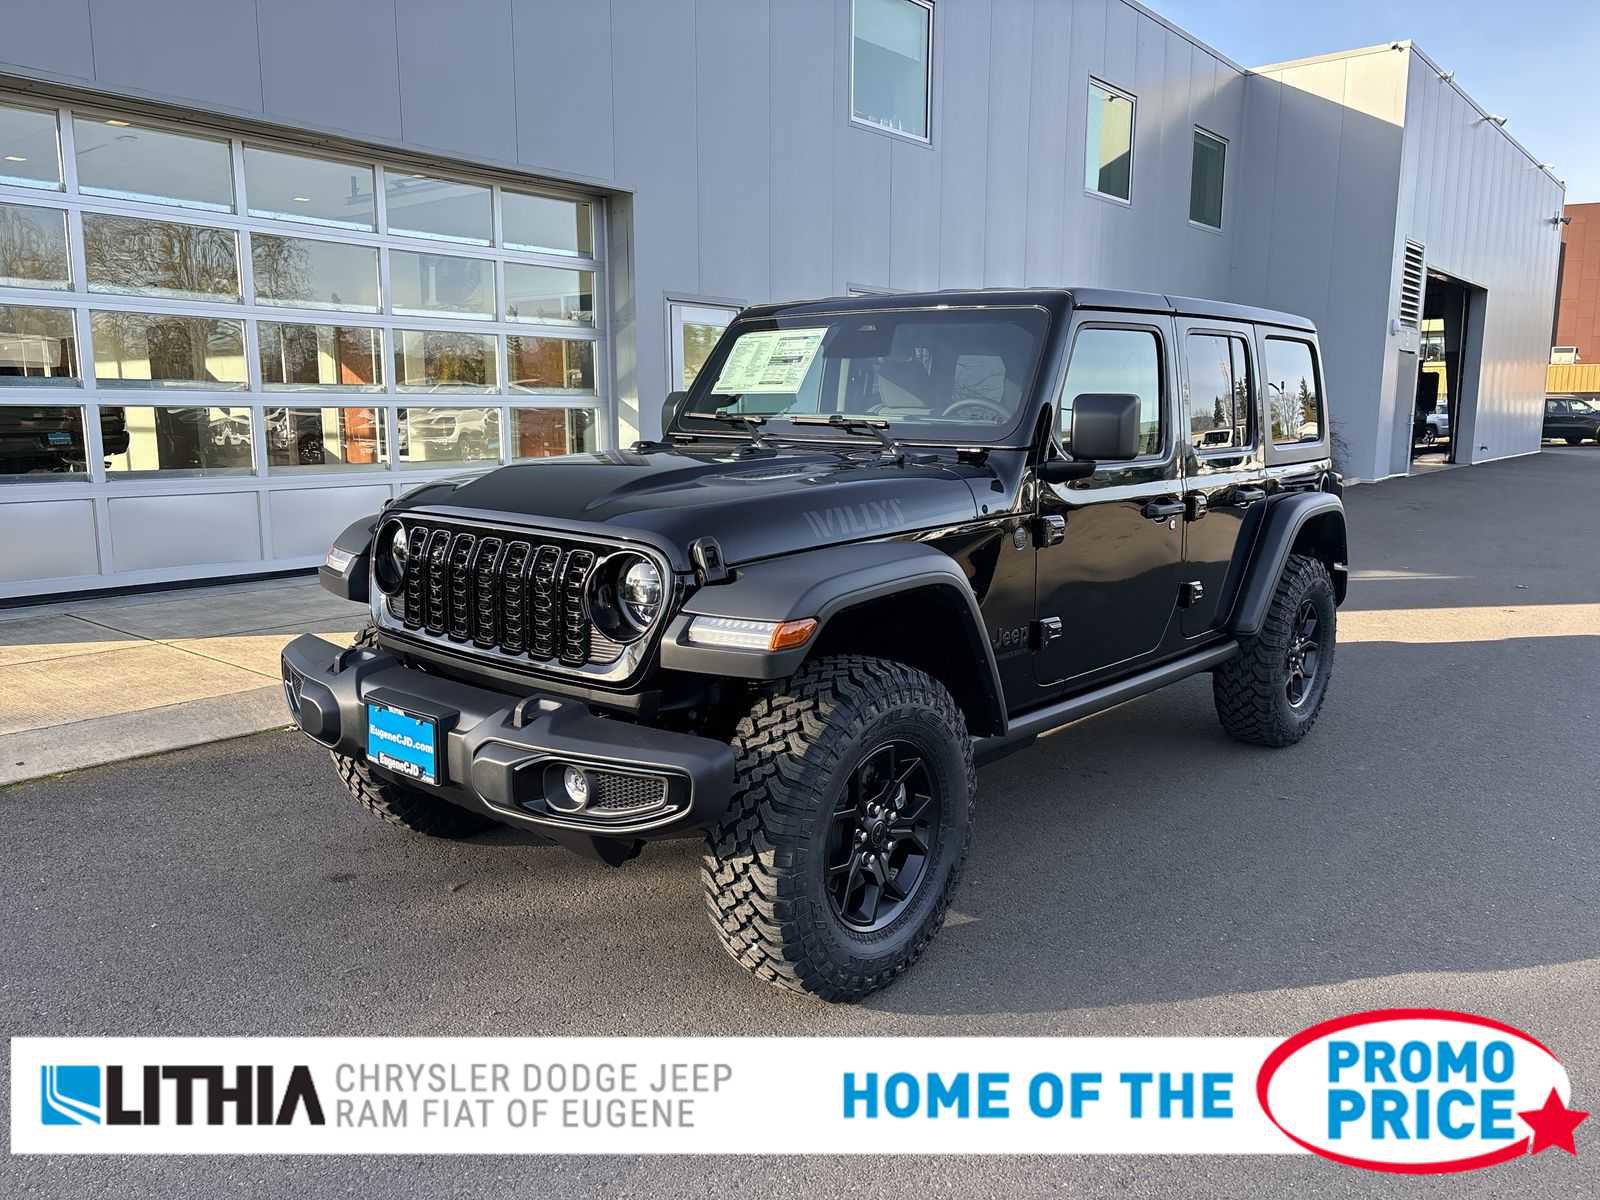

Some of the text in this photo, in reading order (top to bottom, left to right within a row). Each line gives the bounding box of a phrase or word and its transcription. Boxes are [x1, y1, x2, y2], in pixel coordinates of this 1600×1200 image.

[800, 497, 905, 539] WILLYS
[992, 626, 1029, 649] Jeep
[369, 724, 434, 753] EugeneCJD.com
